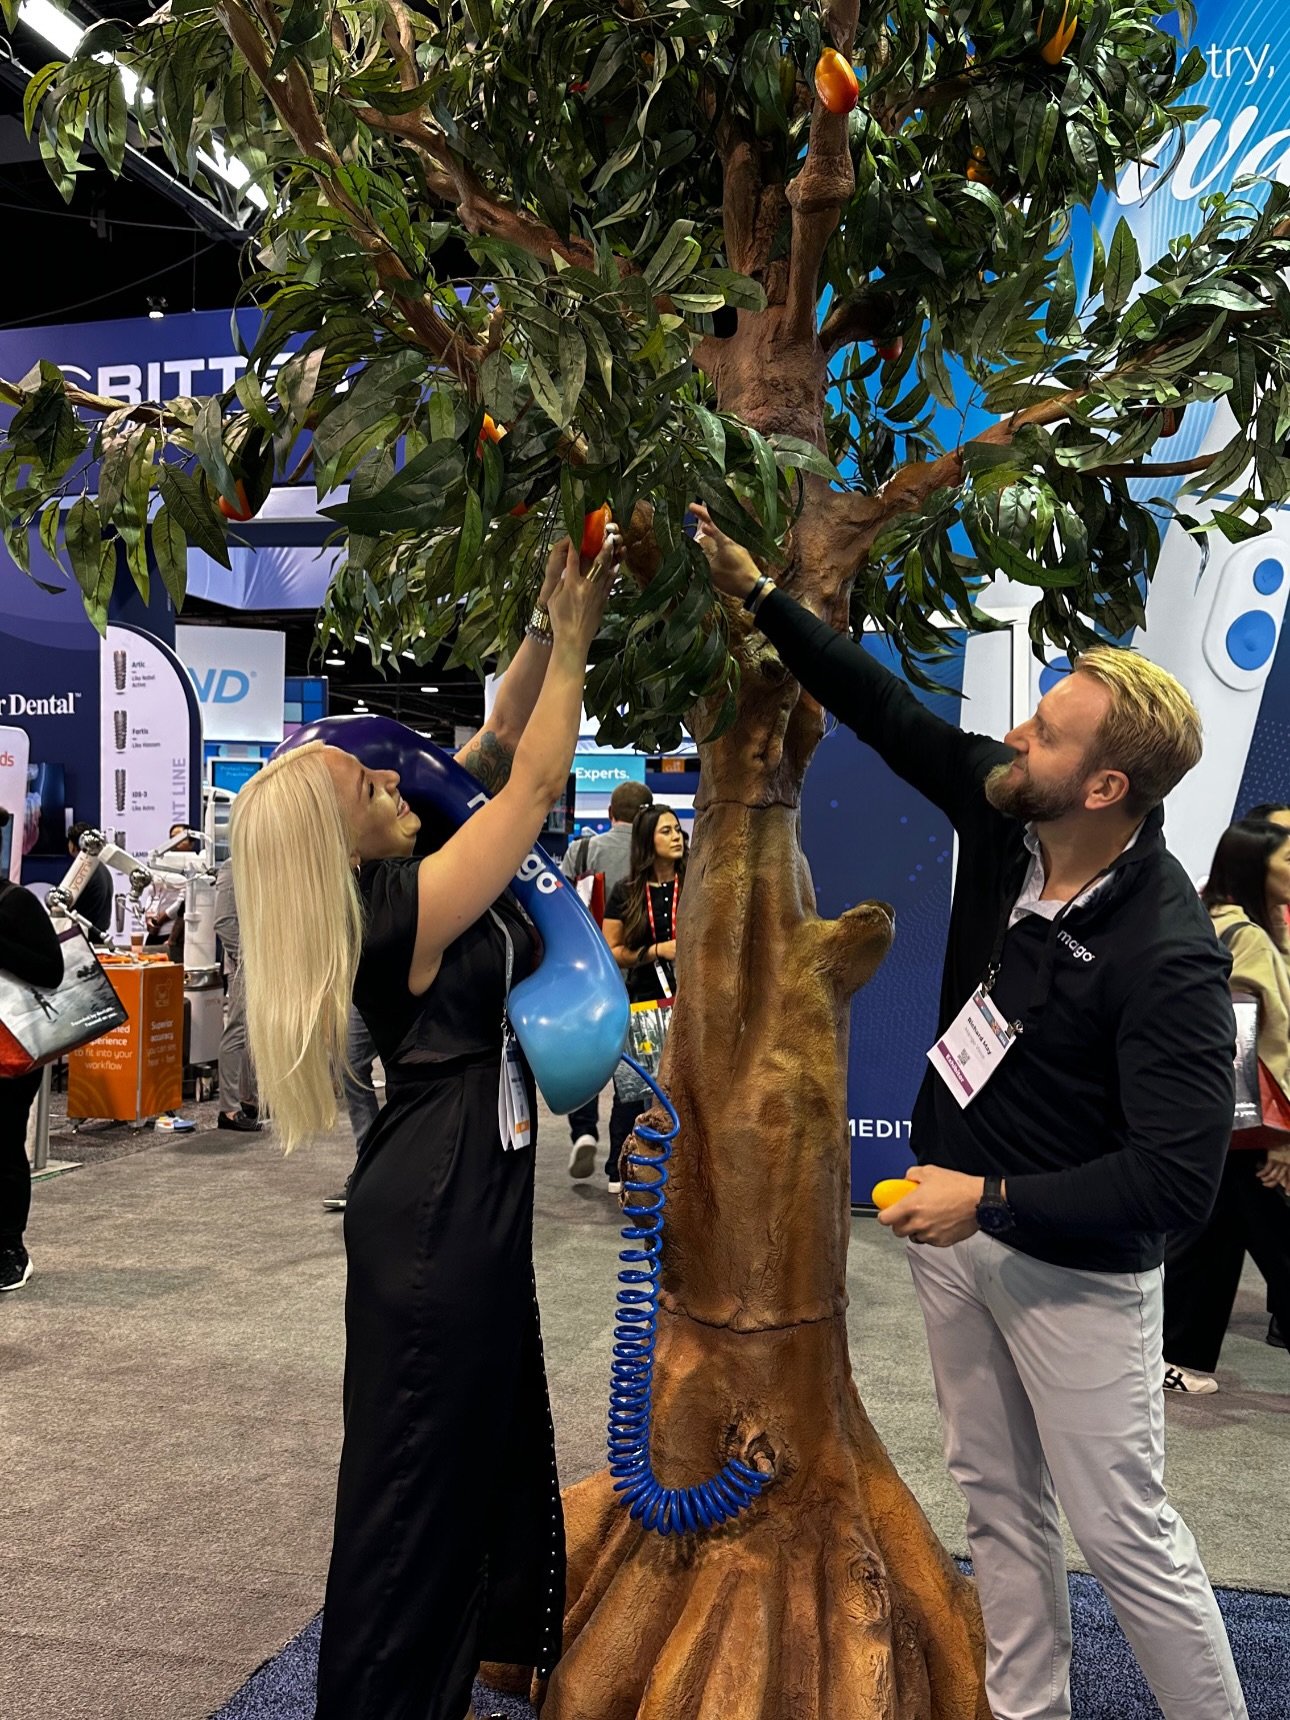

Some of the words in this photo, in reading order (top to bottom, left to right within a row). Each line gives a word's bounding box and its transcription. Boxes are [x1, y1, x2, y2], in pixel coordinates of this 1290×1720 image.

[1181, 43, 1275, 86] try,
[172, 758, 186, 796] LINE
[575, 767, 630, 782] Experts.
[85, 1048, 94, 1057] fit
[96, 1050, 113, 1058] into
[113, 1051, 133, 1060] your
[85, 1061, 122, 1070] workflow
